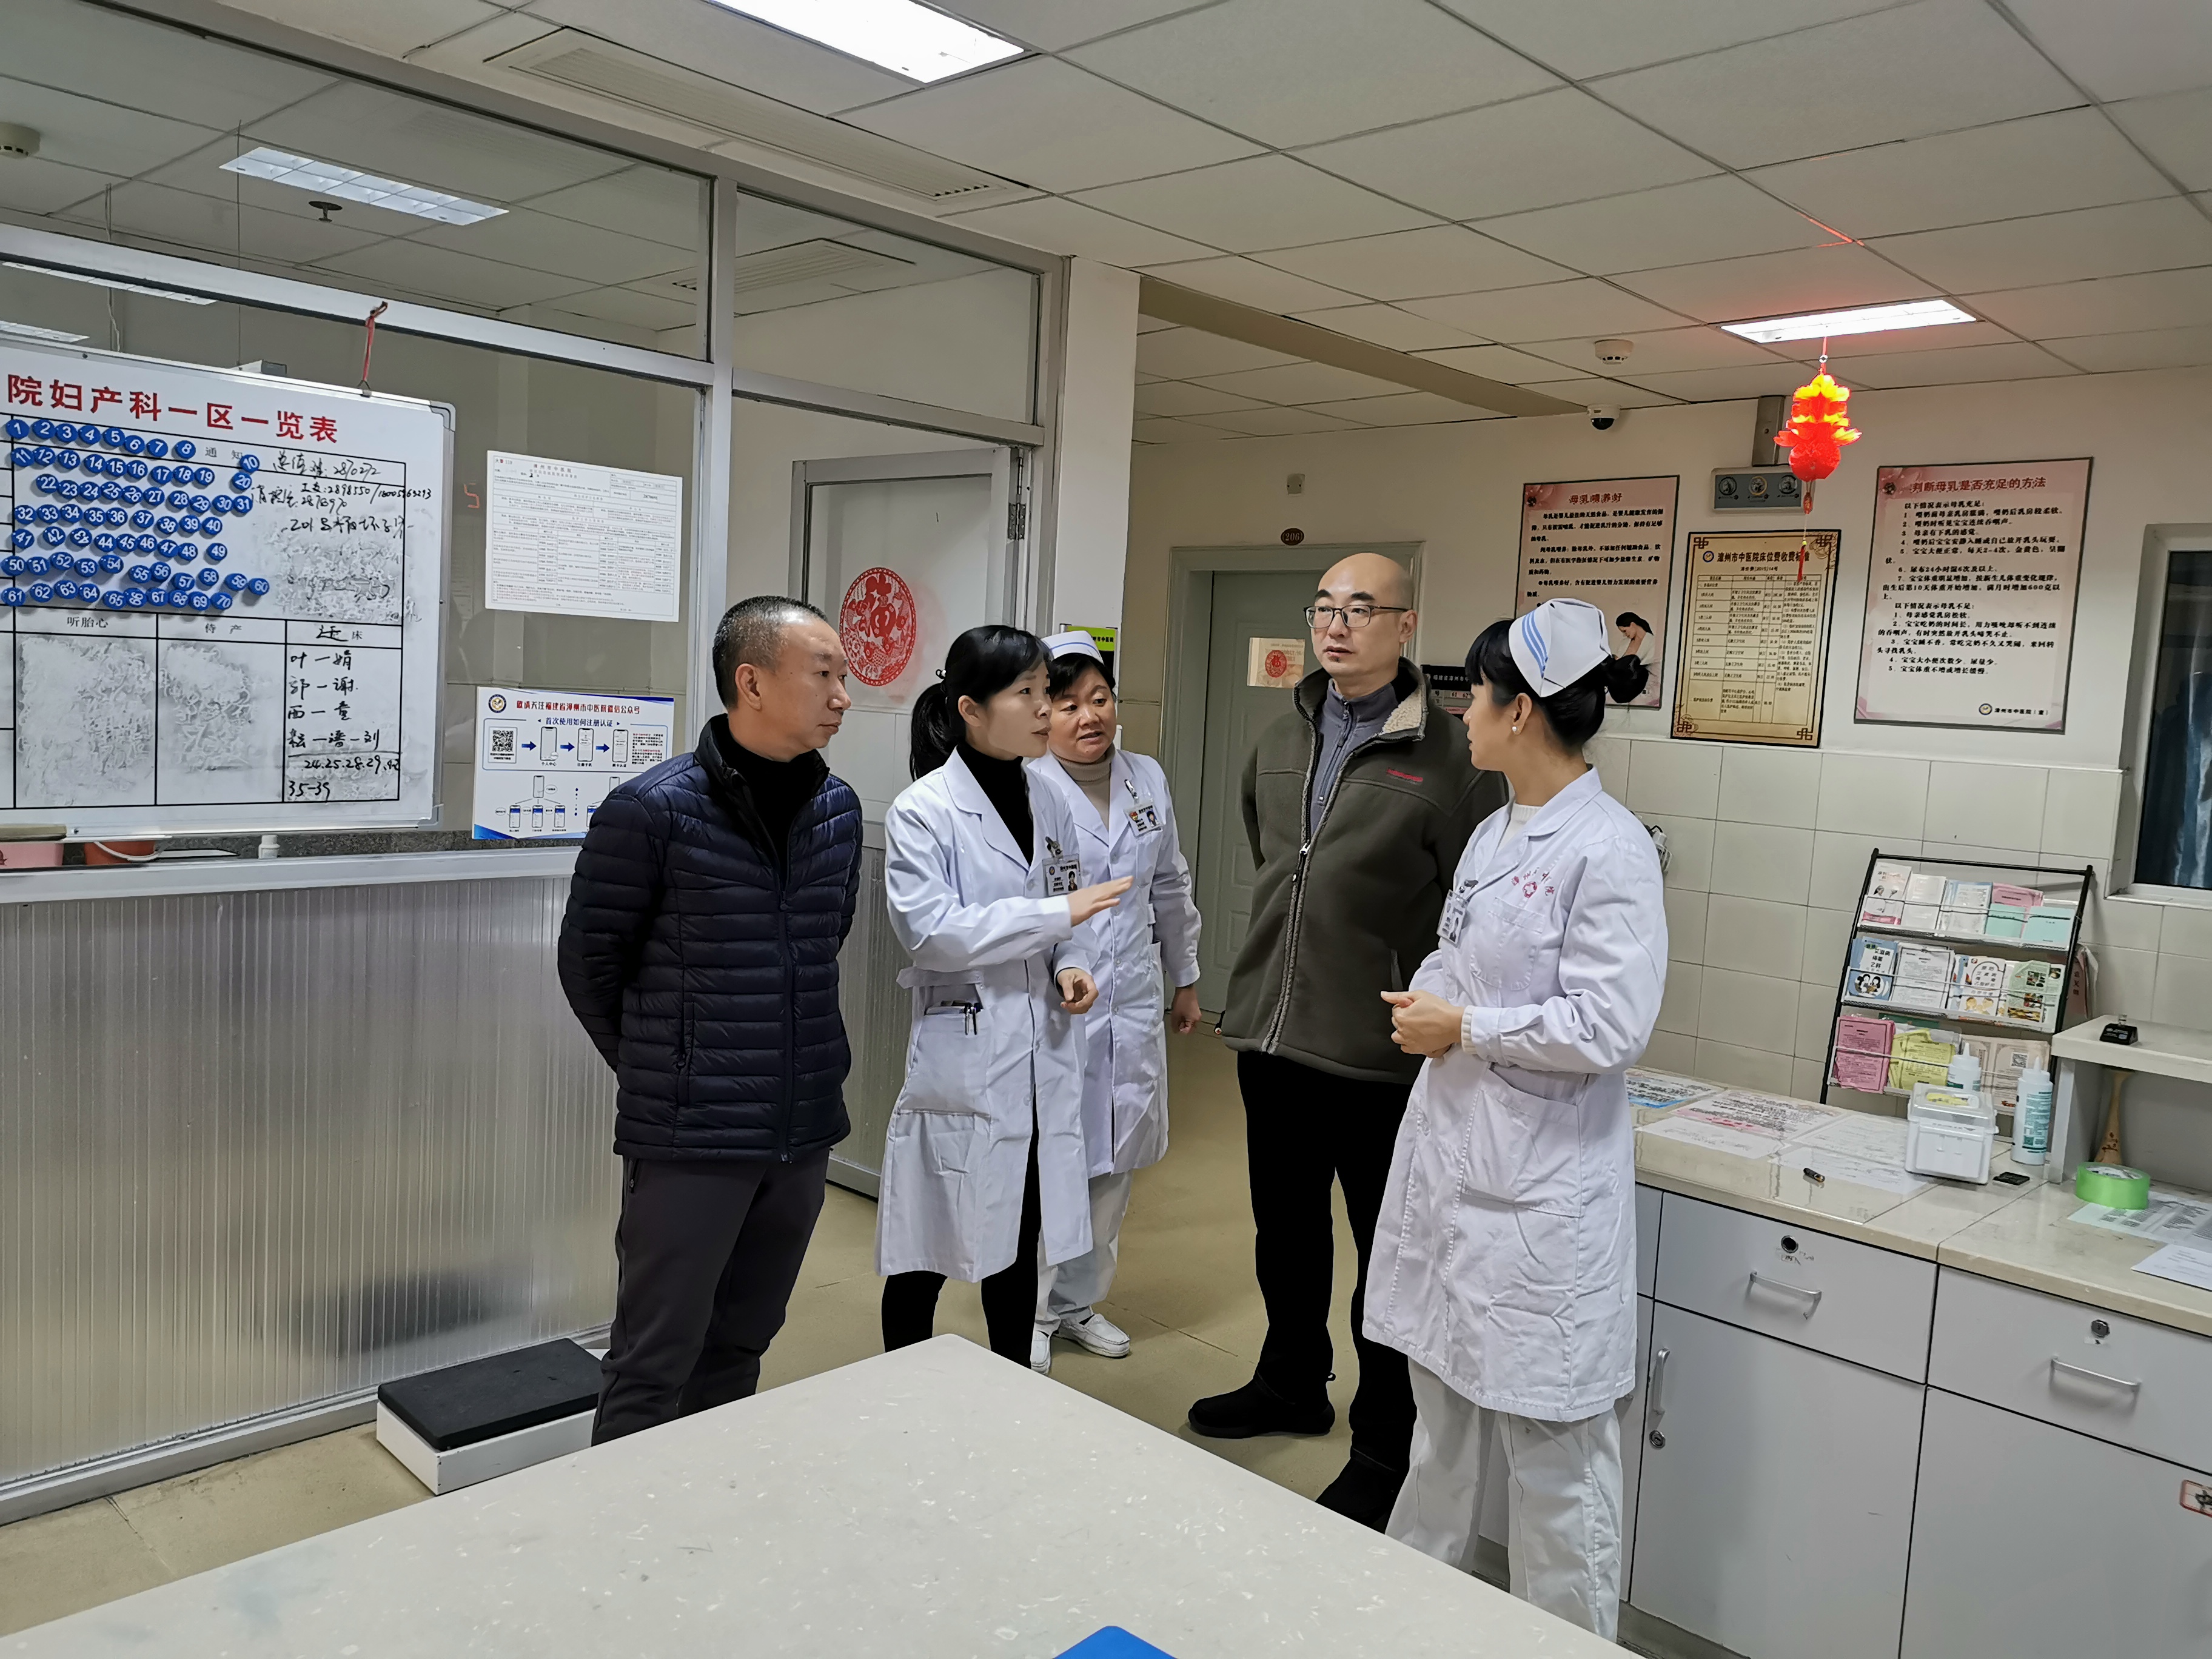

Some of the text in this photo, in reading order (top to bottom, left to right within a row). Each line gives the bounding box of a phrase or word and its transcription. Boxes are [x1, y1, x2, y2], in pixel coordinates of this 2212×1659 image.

[7, 374, 338, 444] 院妇产科一区一览表
[14, 422, 192, 455] 1 2 3 4 5 6 7 8
[16, 449, 250, 488] 11 12 13 14 15 16 17 18 19 20
[243, 457, 258, 469] 10
[41, 477, 249, 511] 22 23 24 25 26 27 28 29 30 31
[1911, 477, 2046, 492] 判断母乳是否充足的方法
[1569, 493, 1623, 504] 母乳喂养好
[18, 506, 220, 532] 32 33 34 35 36 37 38 39 40
[16, 529, 226, 557] 41 42 43 44 45 46 47 48 49
[9, 554, 268, 592] 50 51 52 53 54 55 56 57 58 59 60
[8, 592, 22, 602] 61
[35, 586, 50, 598] 62
[60, 582, 76, 596] 63
[83, 587, 98, 598] 64
[109, 594, 123, 606] 65
[152, 591, 165, 603] 67
[173, 592, 188, 605] 68
[193, 596, 207, 607] 69
[217, 595, 231, 608] 70
[67, 615, 109, 628] 听胎心
[205, 623, 242, 634] 待产
[546, 717, 613, 728] 首次使用如何注册认证
